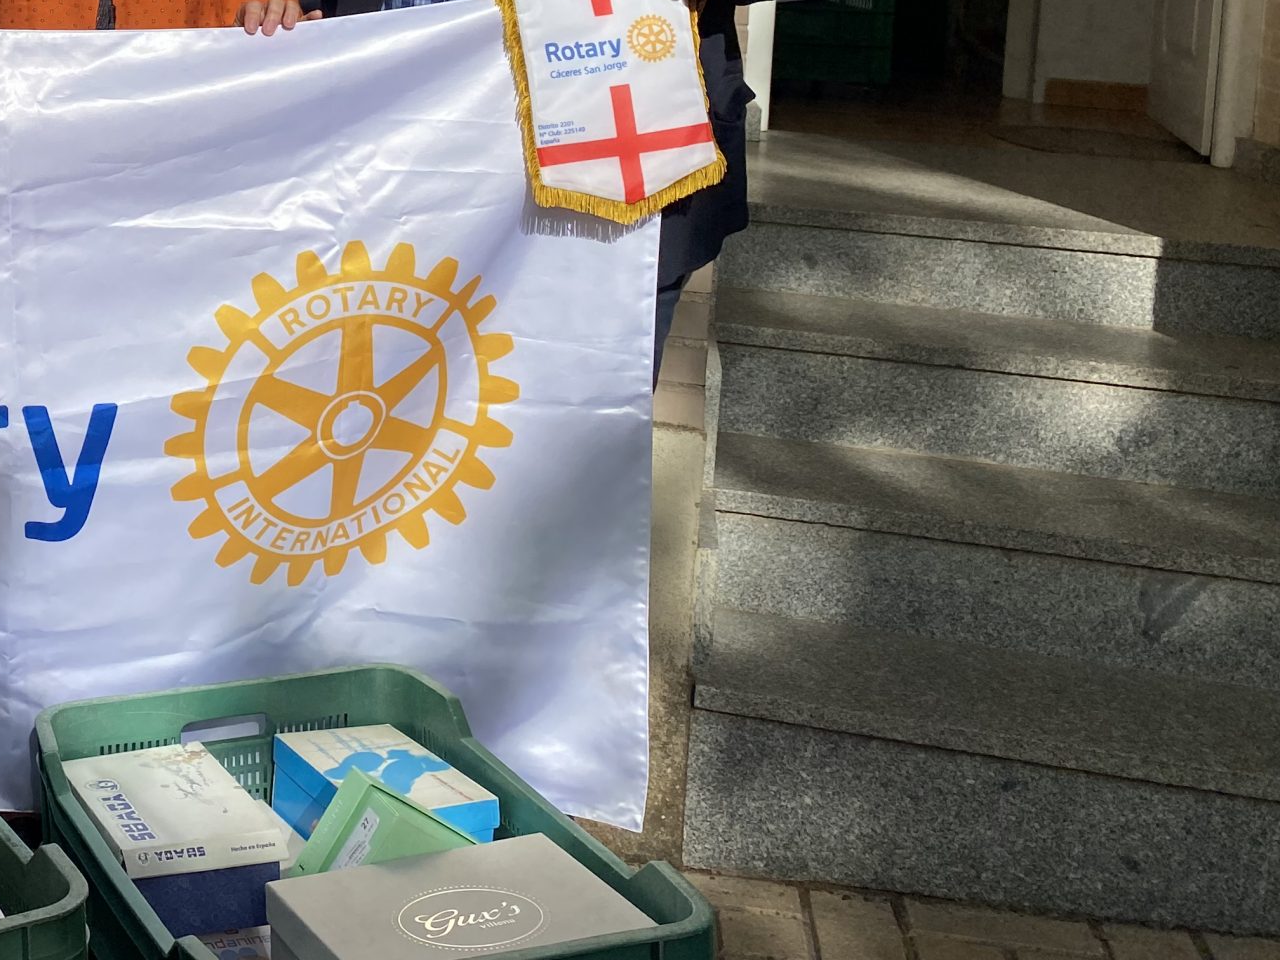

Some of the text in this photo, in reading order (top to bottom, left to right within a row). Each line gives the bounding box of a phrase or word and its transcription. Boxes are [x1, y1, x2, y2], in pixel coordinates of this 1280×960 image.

[545, 38, 621, 62] Rotary
[550, 60, 628, 79] Cáceres San Jorge
[278, 285, 434, 336] ROTARY
[227, 446, 461, 552] INTERNATIONAL
